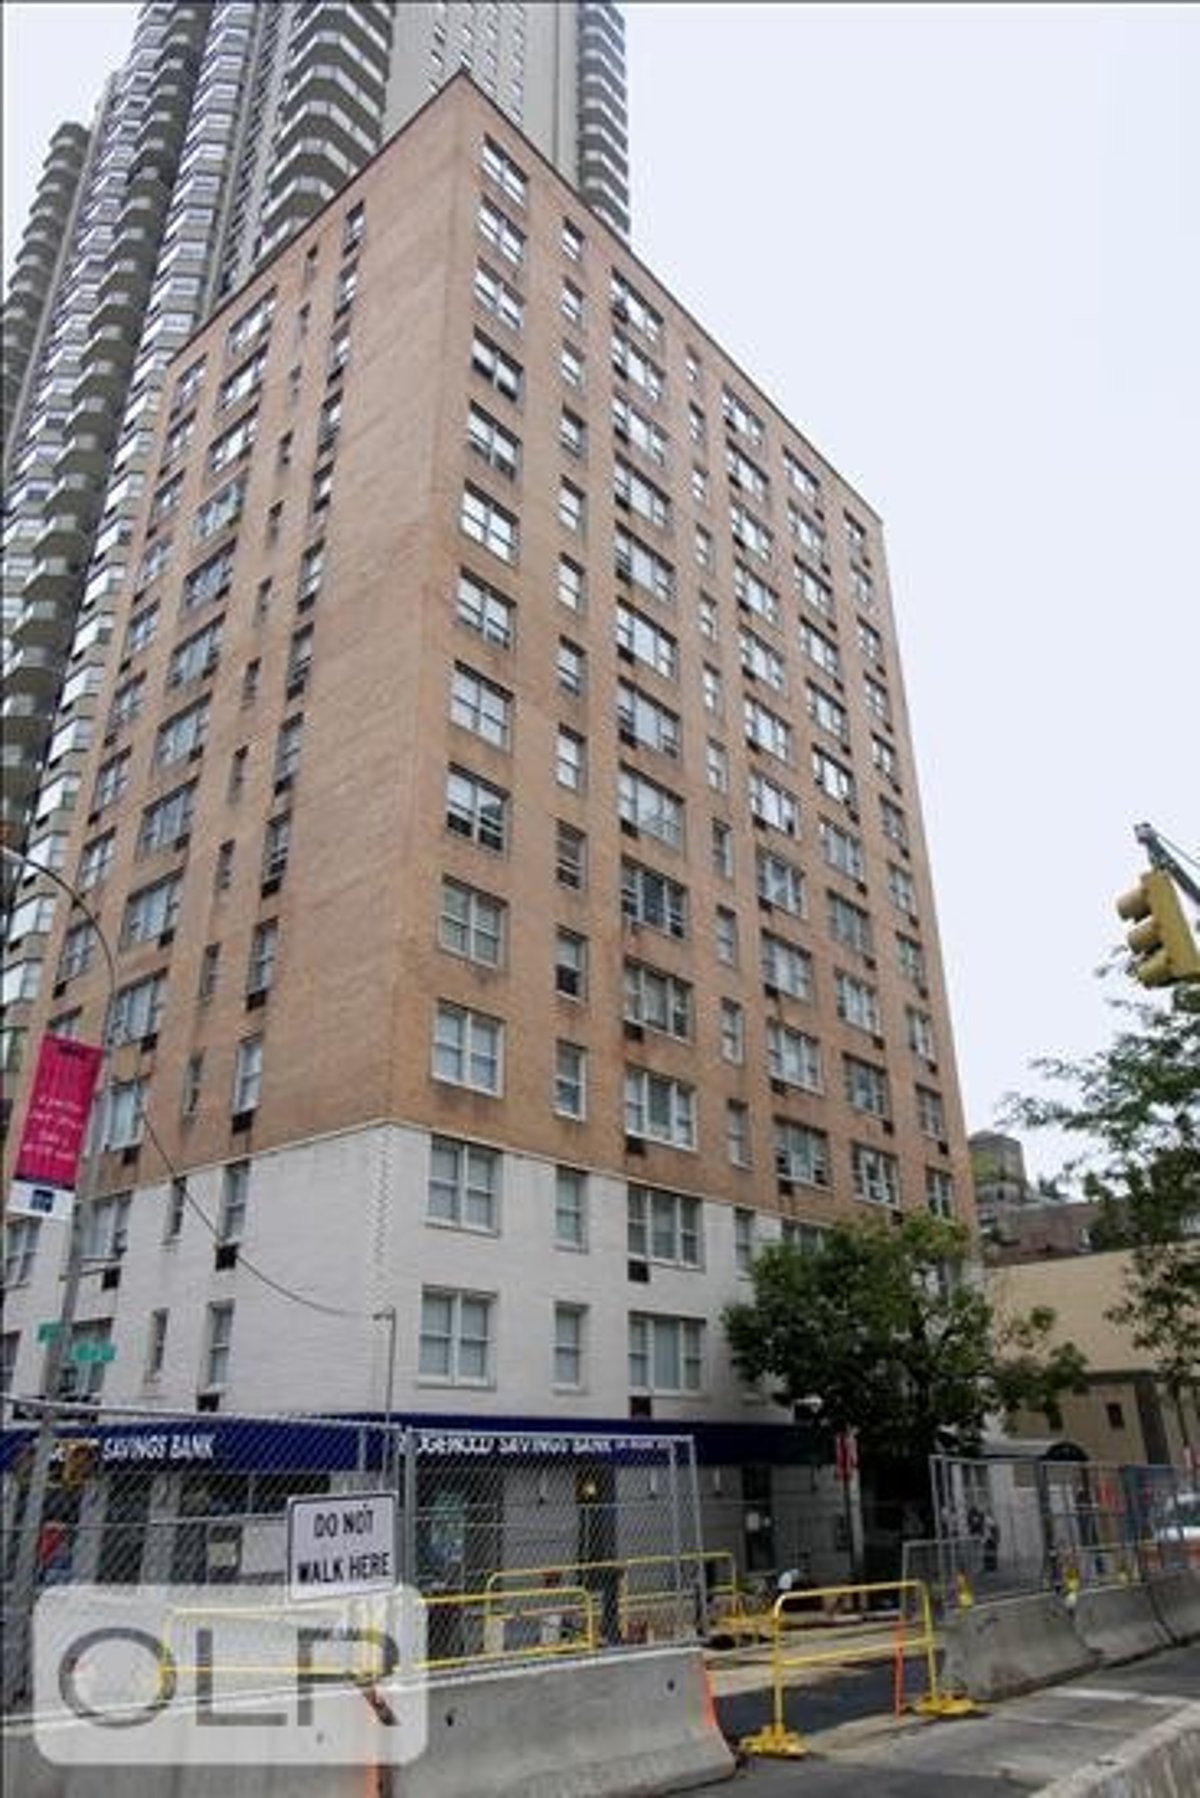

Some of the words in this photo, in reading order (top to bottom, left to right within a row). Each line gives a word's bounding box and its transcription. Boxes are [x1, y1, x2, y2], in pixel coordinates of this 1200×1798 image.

[103, 1434, 167, 1461] SAVINGS
[169, 1434, 215, 1460] BANK
[572, 1437, 613, 1454] BANK
[314, 1513, 338, 1538] DO
[343, 1509, 374, 1534] NOT
[298, 1559, 344, 1584] WALK
[349, 1552, 390, 1580] HERE
